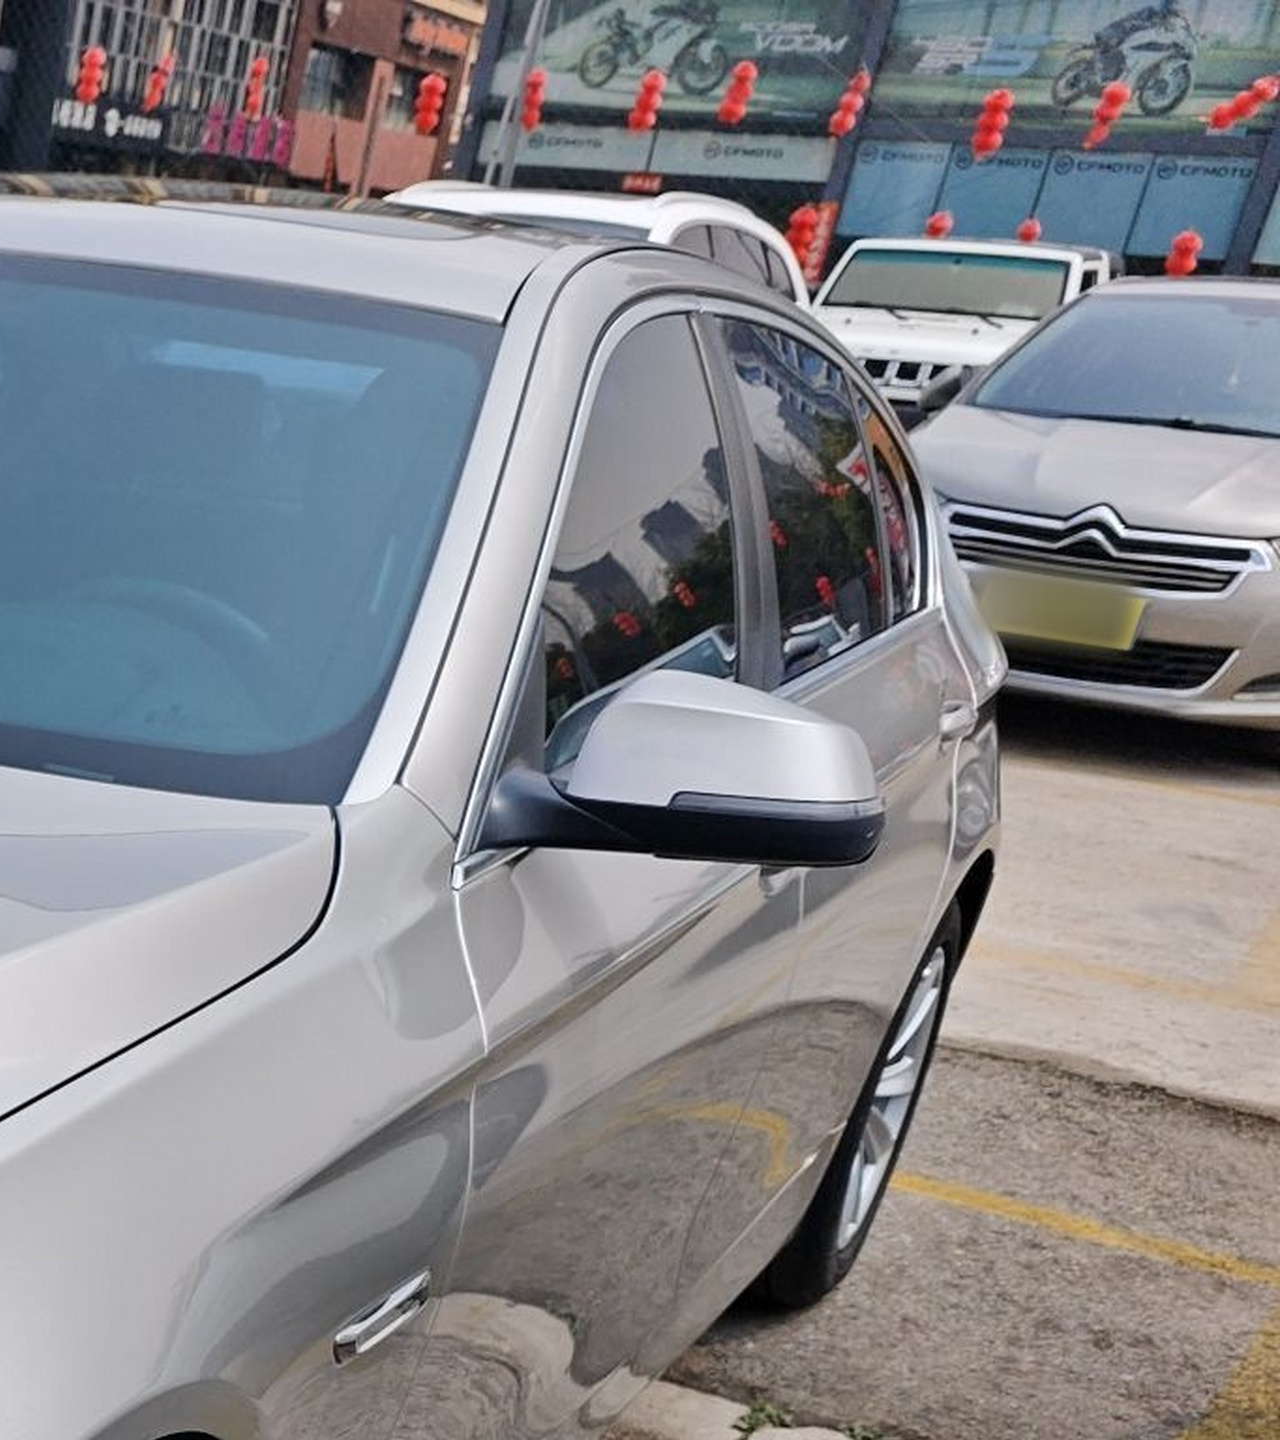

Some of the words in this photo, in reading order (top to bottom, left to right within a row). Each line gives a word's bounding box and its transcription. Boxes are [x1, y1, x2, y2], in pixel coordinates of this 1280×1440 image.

[724, 145, 784, 160] CFMOTO
[1077, 160, 1146, 176] CFMOTO
[1180, 164, 1253, 179] CFMOTO
